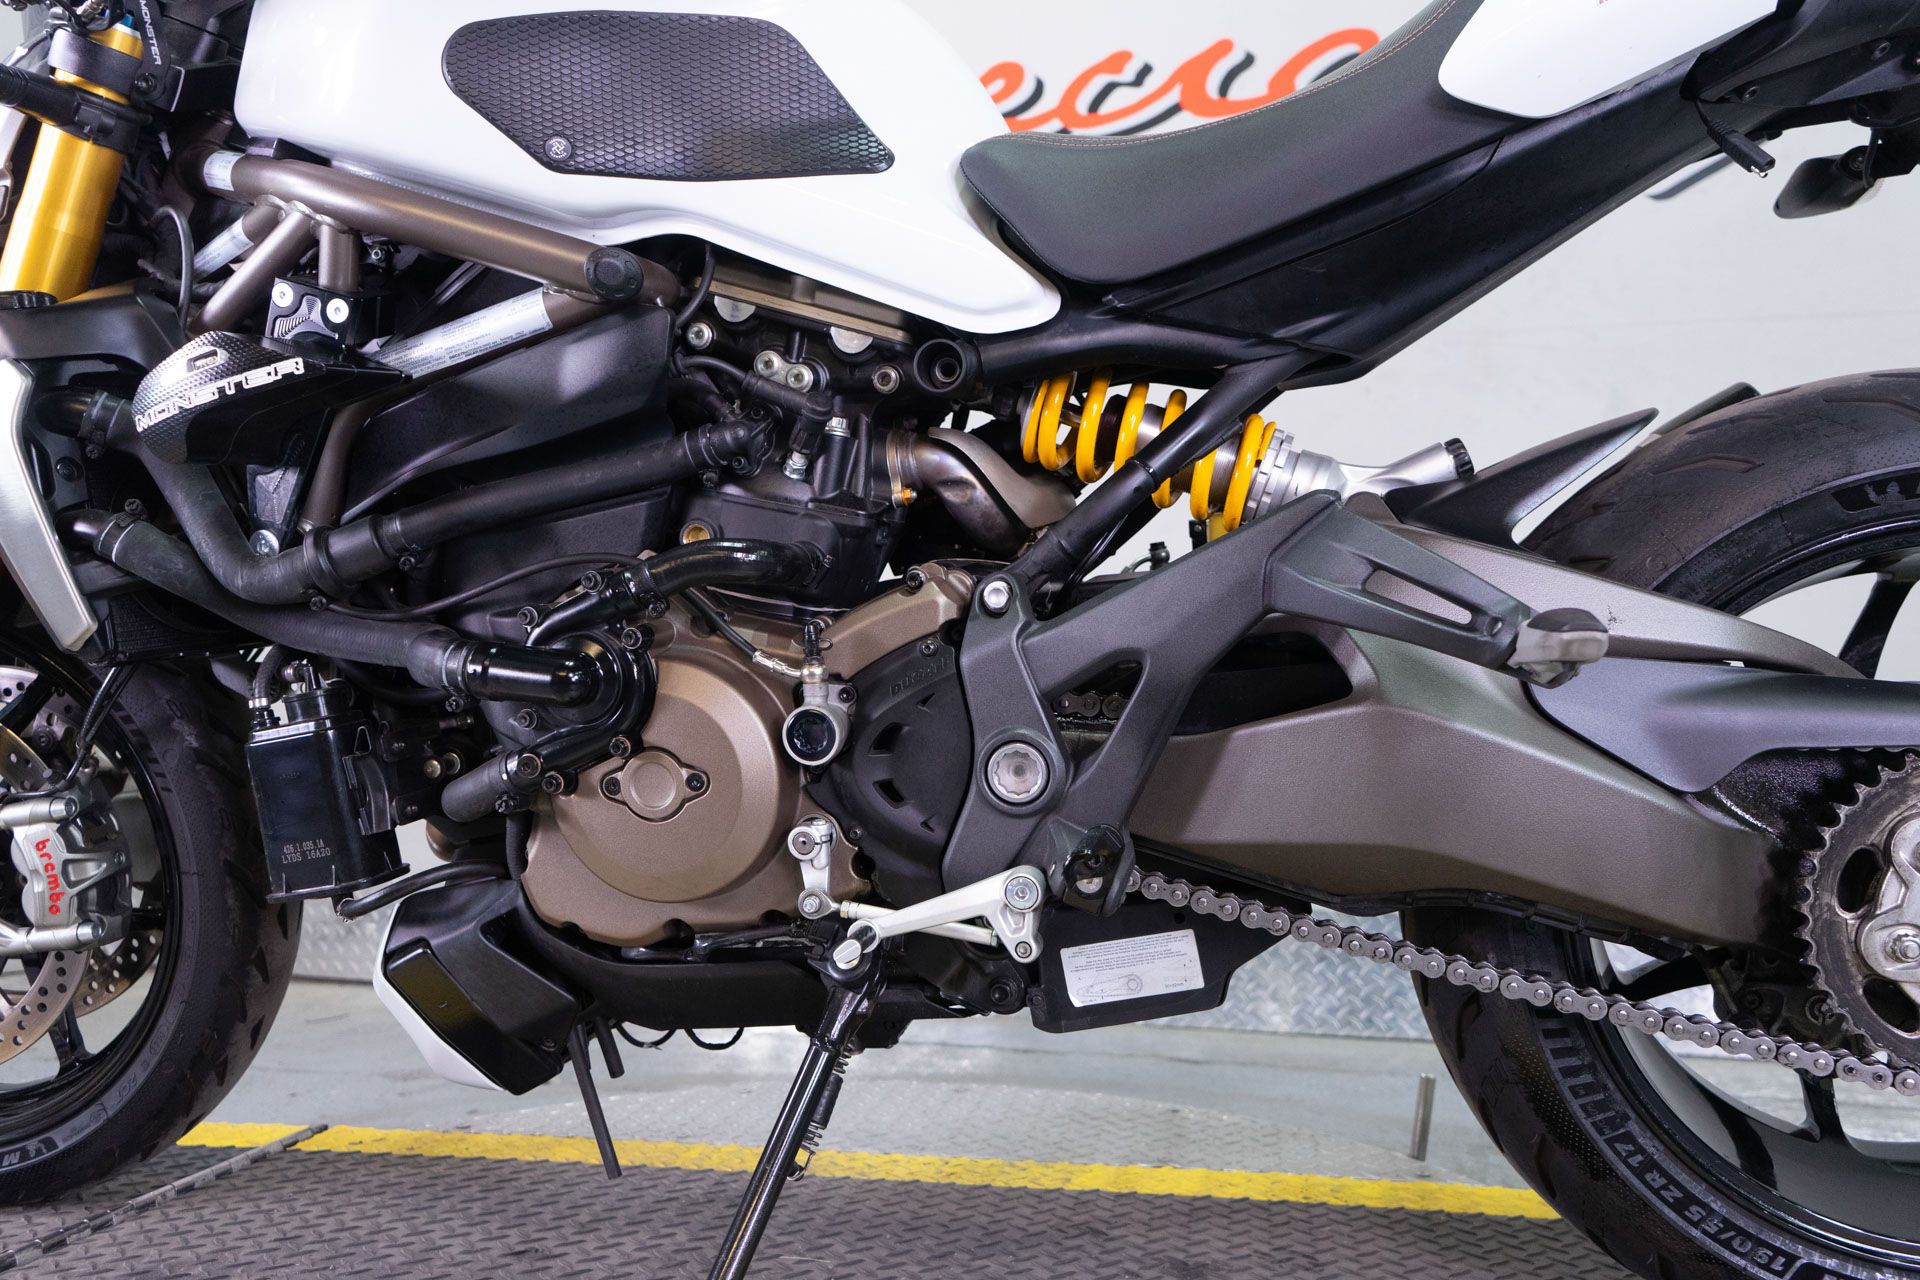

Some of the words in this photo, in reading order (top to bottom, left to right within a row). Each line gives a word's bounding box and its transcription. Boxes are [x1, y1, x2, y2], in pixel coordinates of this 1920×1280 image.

[140, 0, 161, 65] MONSTER
[134, 357, 305, 433] MONSTER
[35, 838, 65, 915] brembo
[282, 852, 302, 864] LYDS
[1613, 1142, 1643, 1167] 17
[1645, 1171, 1684, 1202] ZR
[1684, 1206, 1786, 1272] 190/55
